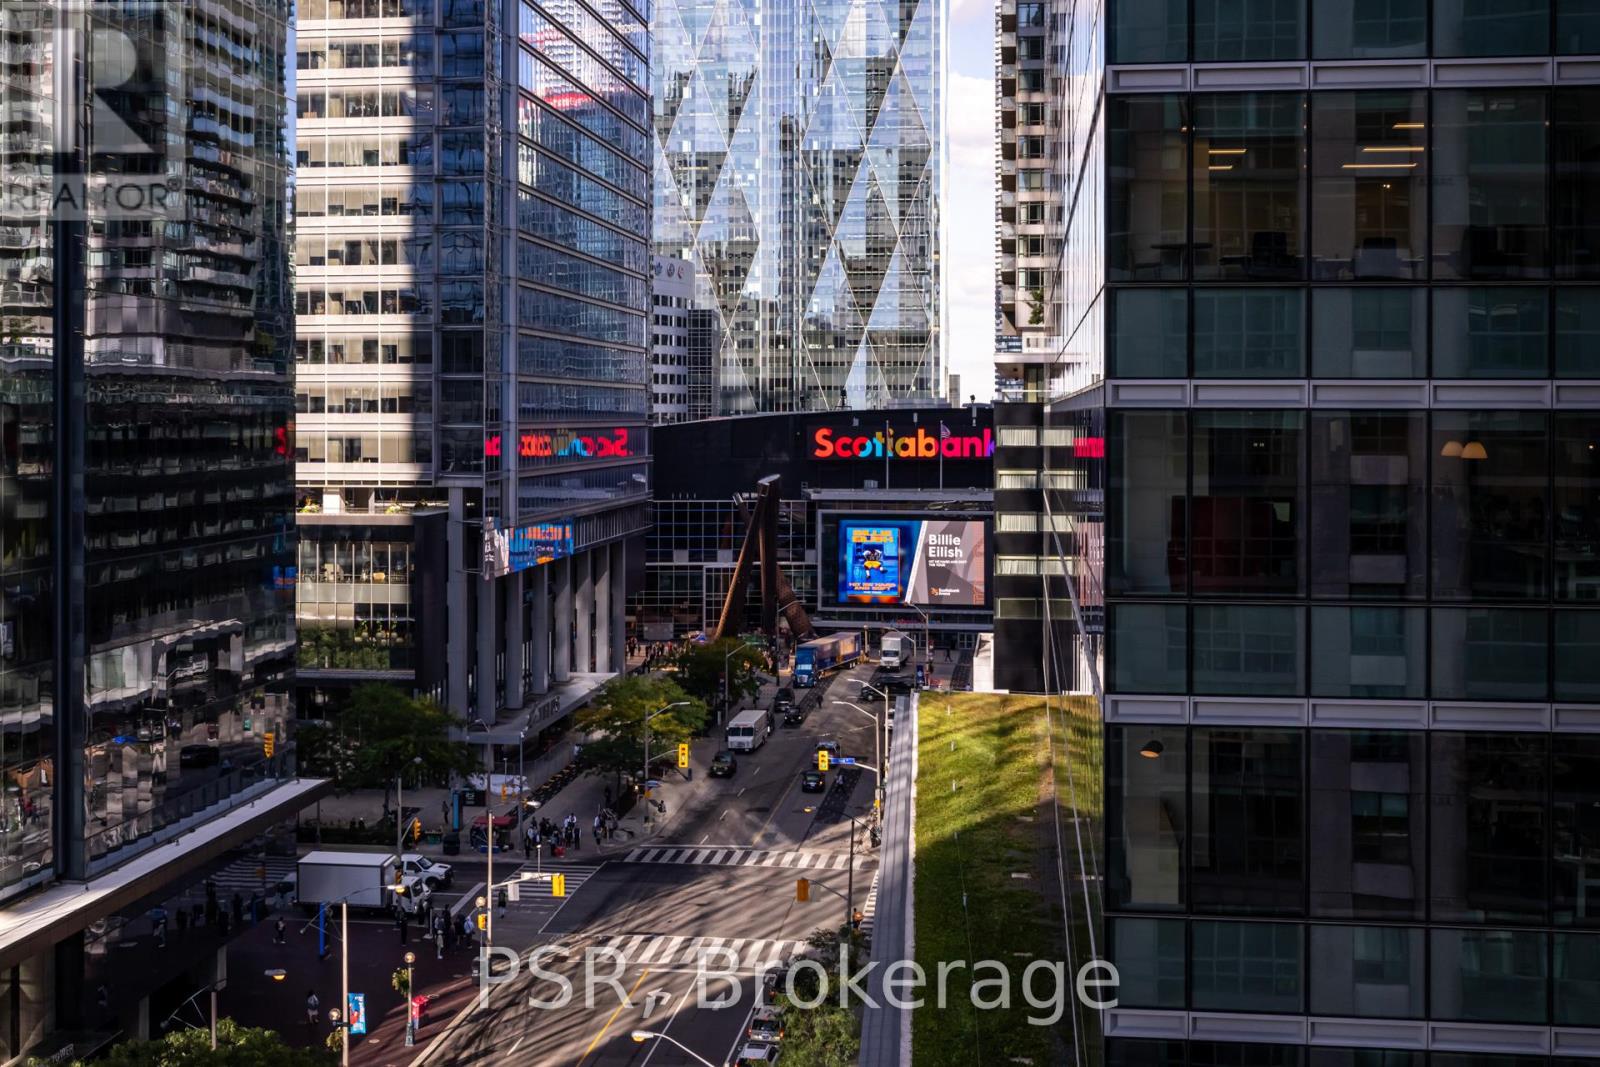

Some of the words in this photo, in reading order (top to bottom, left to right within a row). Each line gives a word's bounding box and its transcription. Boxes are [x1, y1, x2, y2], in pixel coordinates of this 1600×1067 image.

[814, 427, 995, 458] Scotiabank
[928, 534, 961, 546] Billie
[928, 546, 963, 558] Eilish
